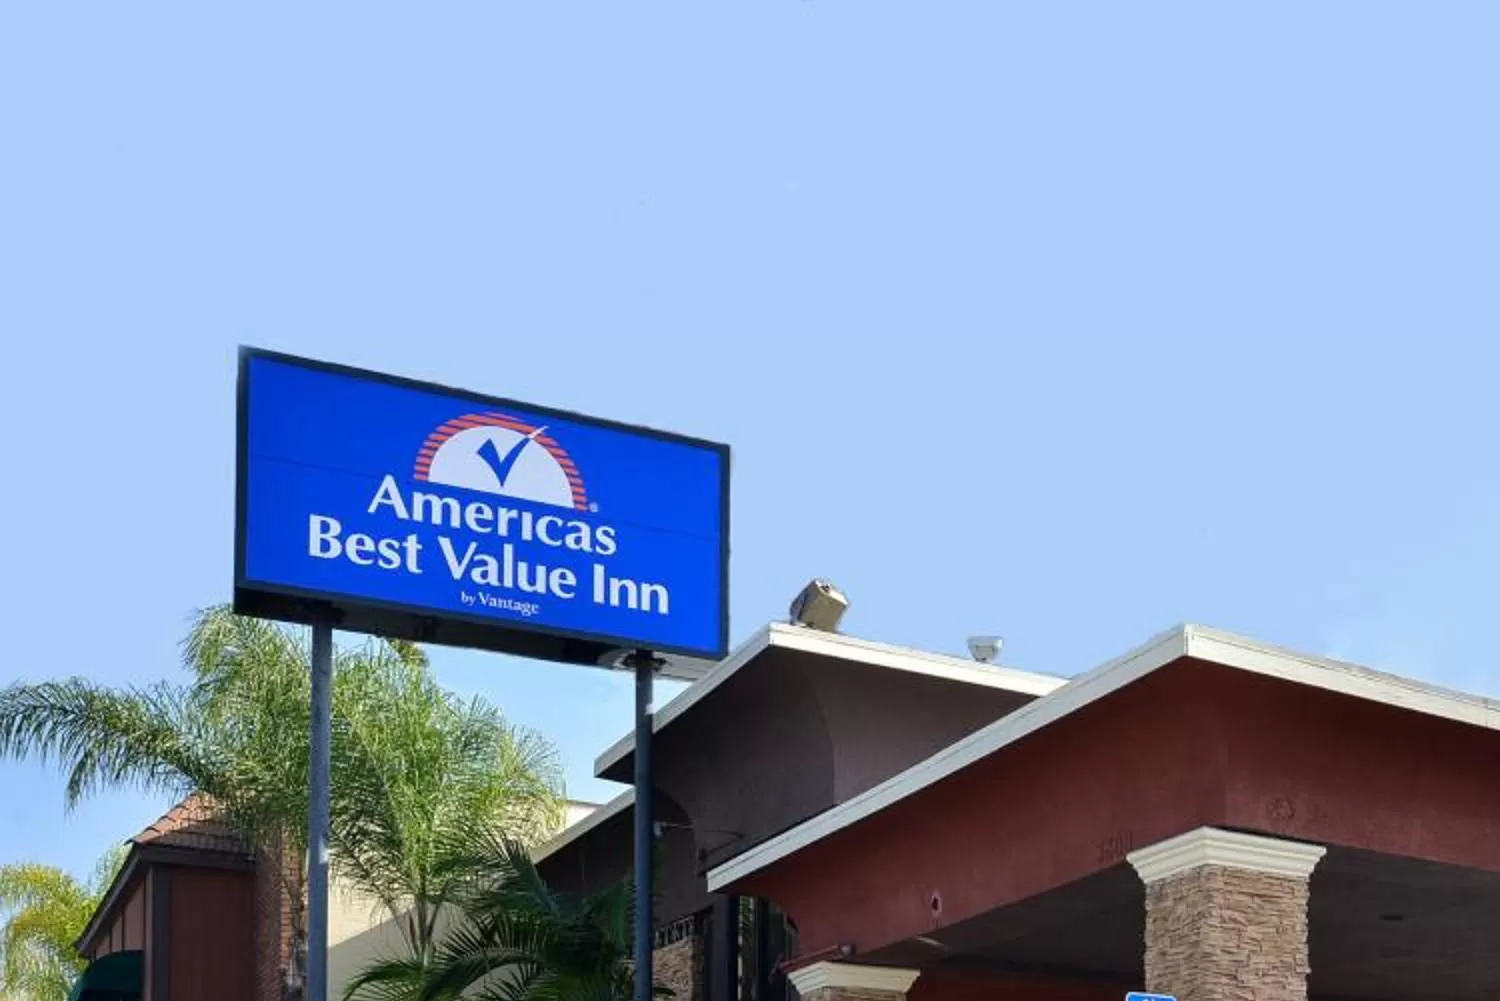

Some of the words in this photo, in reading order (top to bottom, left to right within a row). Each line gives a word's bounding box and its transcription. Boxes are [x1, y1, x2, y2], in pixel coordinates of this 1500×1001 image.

[368, 475, 617, 556] Americas
[308, 514, 423, 574] Best
[438, 536, 577, 600] Value
[593, 565, 670, 615] Inn
[461, 591, 476, 607] by
[478, 591, 540, 617] Vantage
